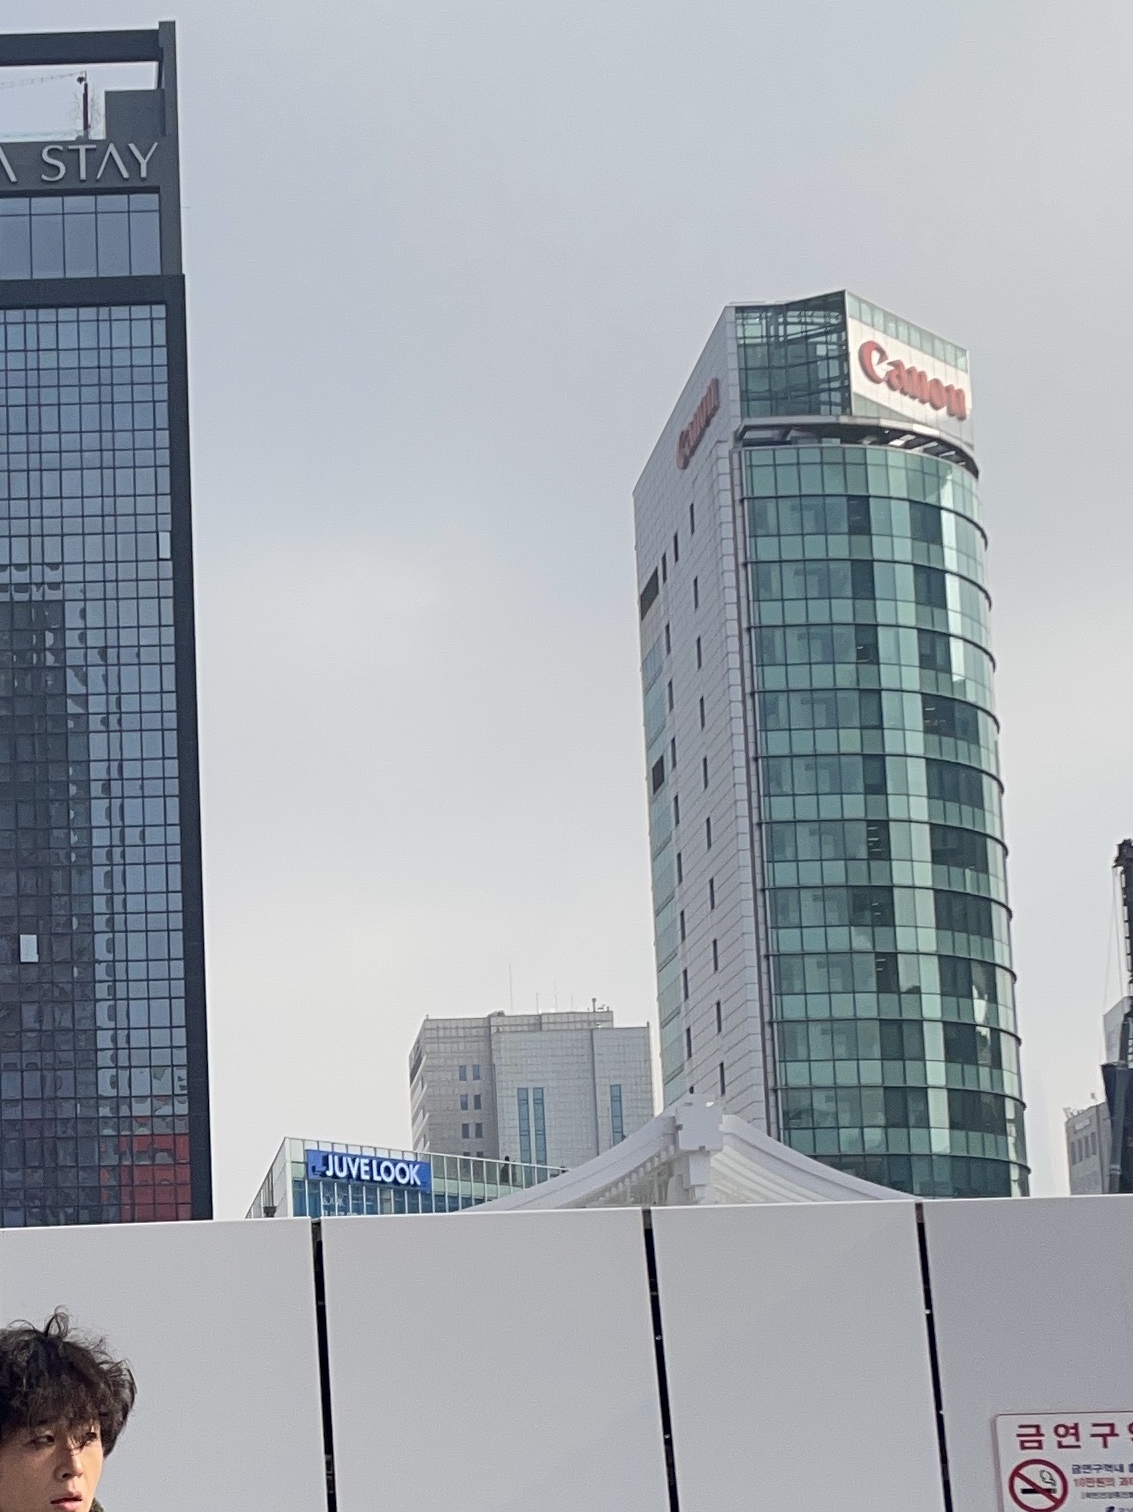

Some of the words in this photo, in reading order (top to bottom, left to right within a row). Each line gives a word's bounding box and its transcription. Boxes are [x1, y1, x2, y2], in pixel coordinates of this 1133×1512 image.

[40, 142, 159, 182] STAY
[858, 339, 967, 421] Canon
[1015, 1422, 1133, 1451] 금연구
